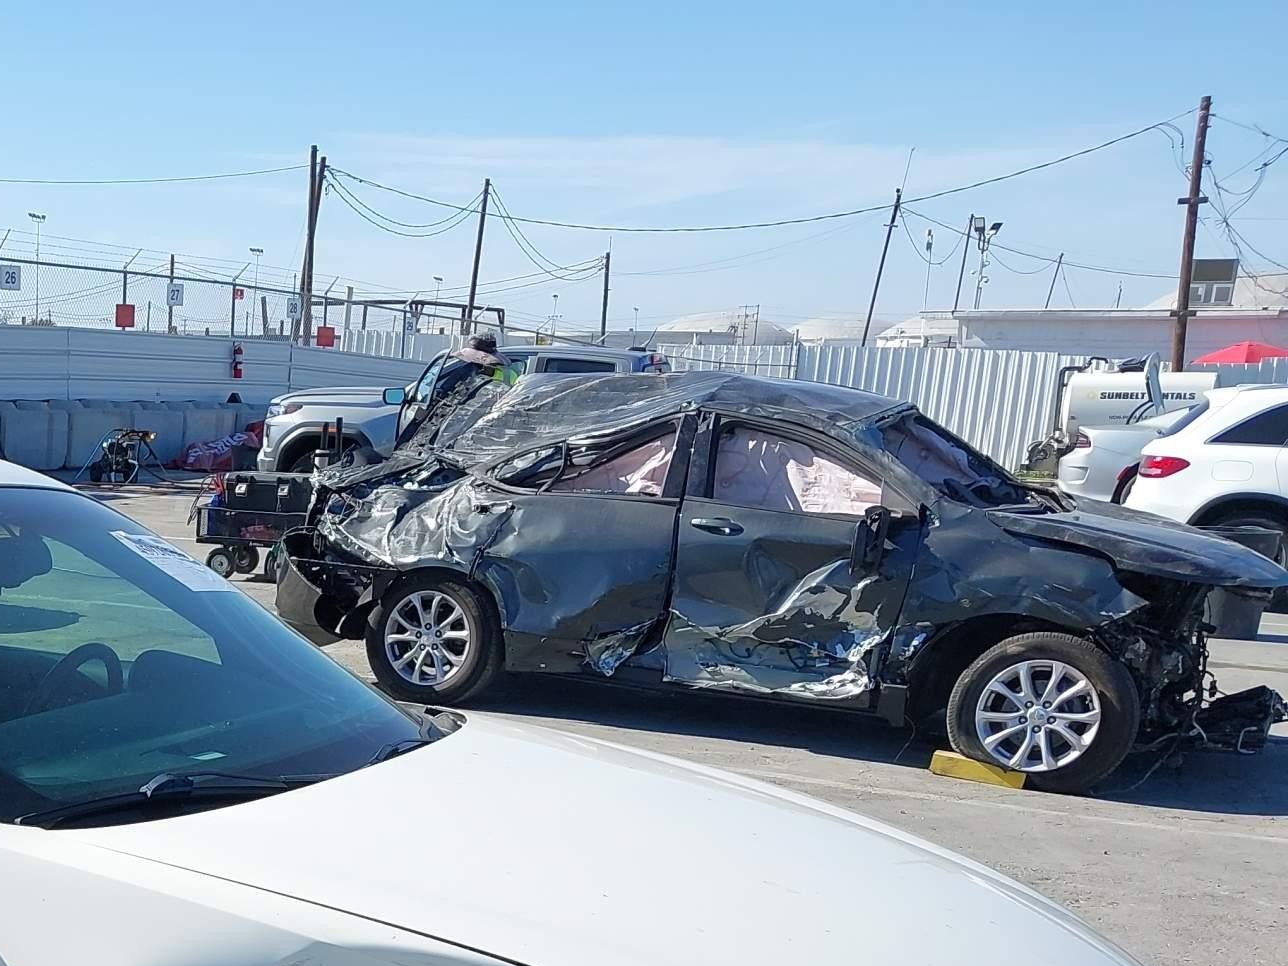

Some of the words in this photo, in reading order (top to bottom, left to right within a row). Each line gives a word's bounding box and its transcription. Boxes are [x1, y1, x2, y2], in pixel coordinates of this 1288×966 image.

[5, 271, 17, 285] 26
[170, 289, 180, 301] 27
[289, 302, 298, 314] 28
[1100, 391, 1146, 400] SUNBELT
[1161, 391, 1197, 400] NTALS
